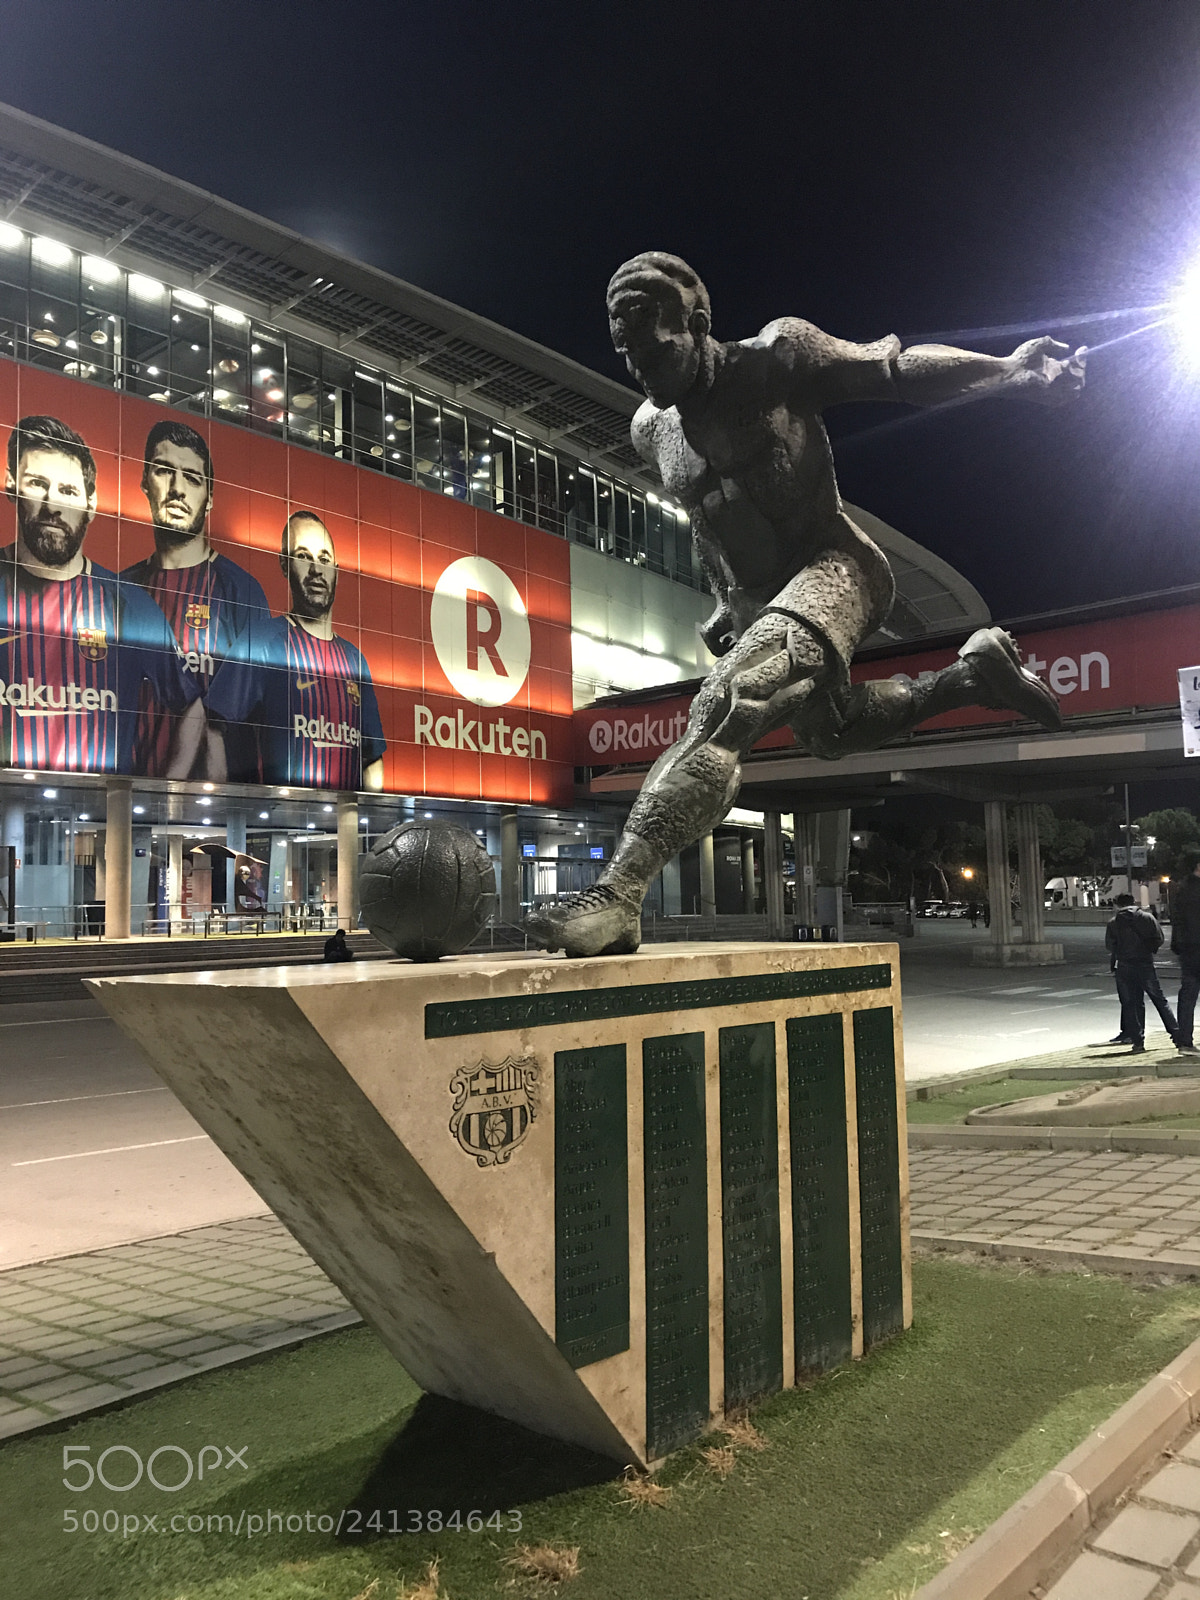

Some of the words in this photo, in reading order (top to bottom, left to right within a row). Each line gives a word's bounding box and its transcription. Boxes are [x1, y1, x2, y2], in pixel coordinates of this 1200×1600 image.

[466, 588, 509, 677] R
[414, 704, 547, 760] Rakuten
[613, 711, 686, 751] Rakut
